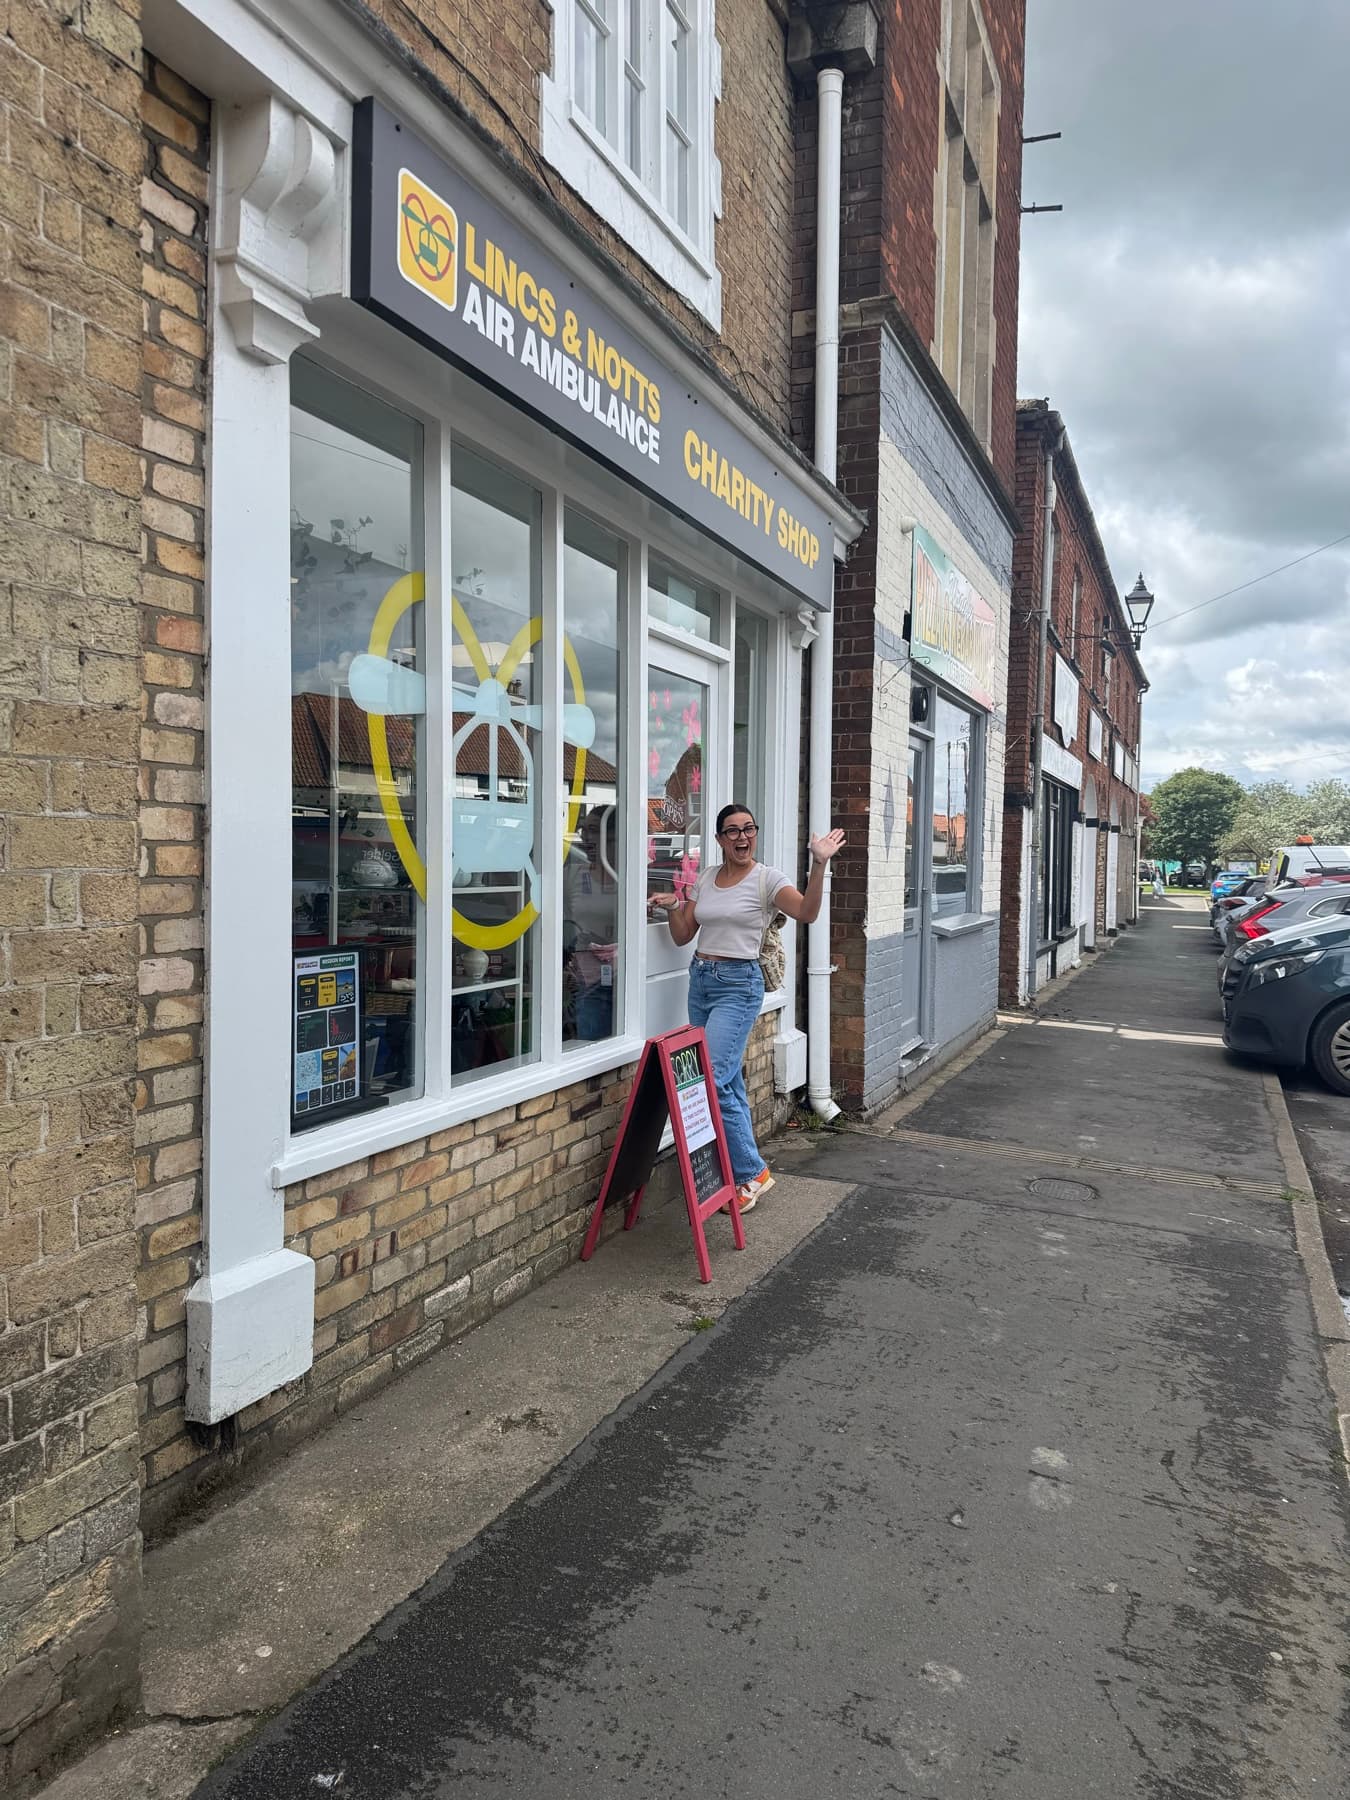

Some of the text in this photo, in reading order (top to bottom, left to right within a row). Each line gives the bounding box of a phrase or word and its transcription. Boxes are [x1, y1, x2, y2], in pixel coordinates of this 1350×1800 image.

[462, 281, 661, 465] AIR AMBULANCE
[465, 222, 661, 424] LINCS & NOTTS
[684, 429, 820, 569] CHARITY SHOP
[915, 543, 942, 650] PIZZA
[663, 803, 684, 824] OPEN
[670, 1046, 700, 1085] SORRY
